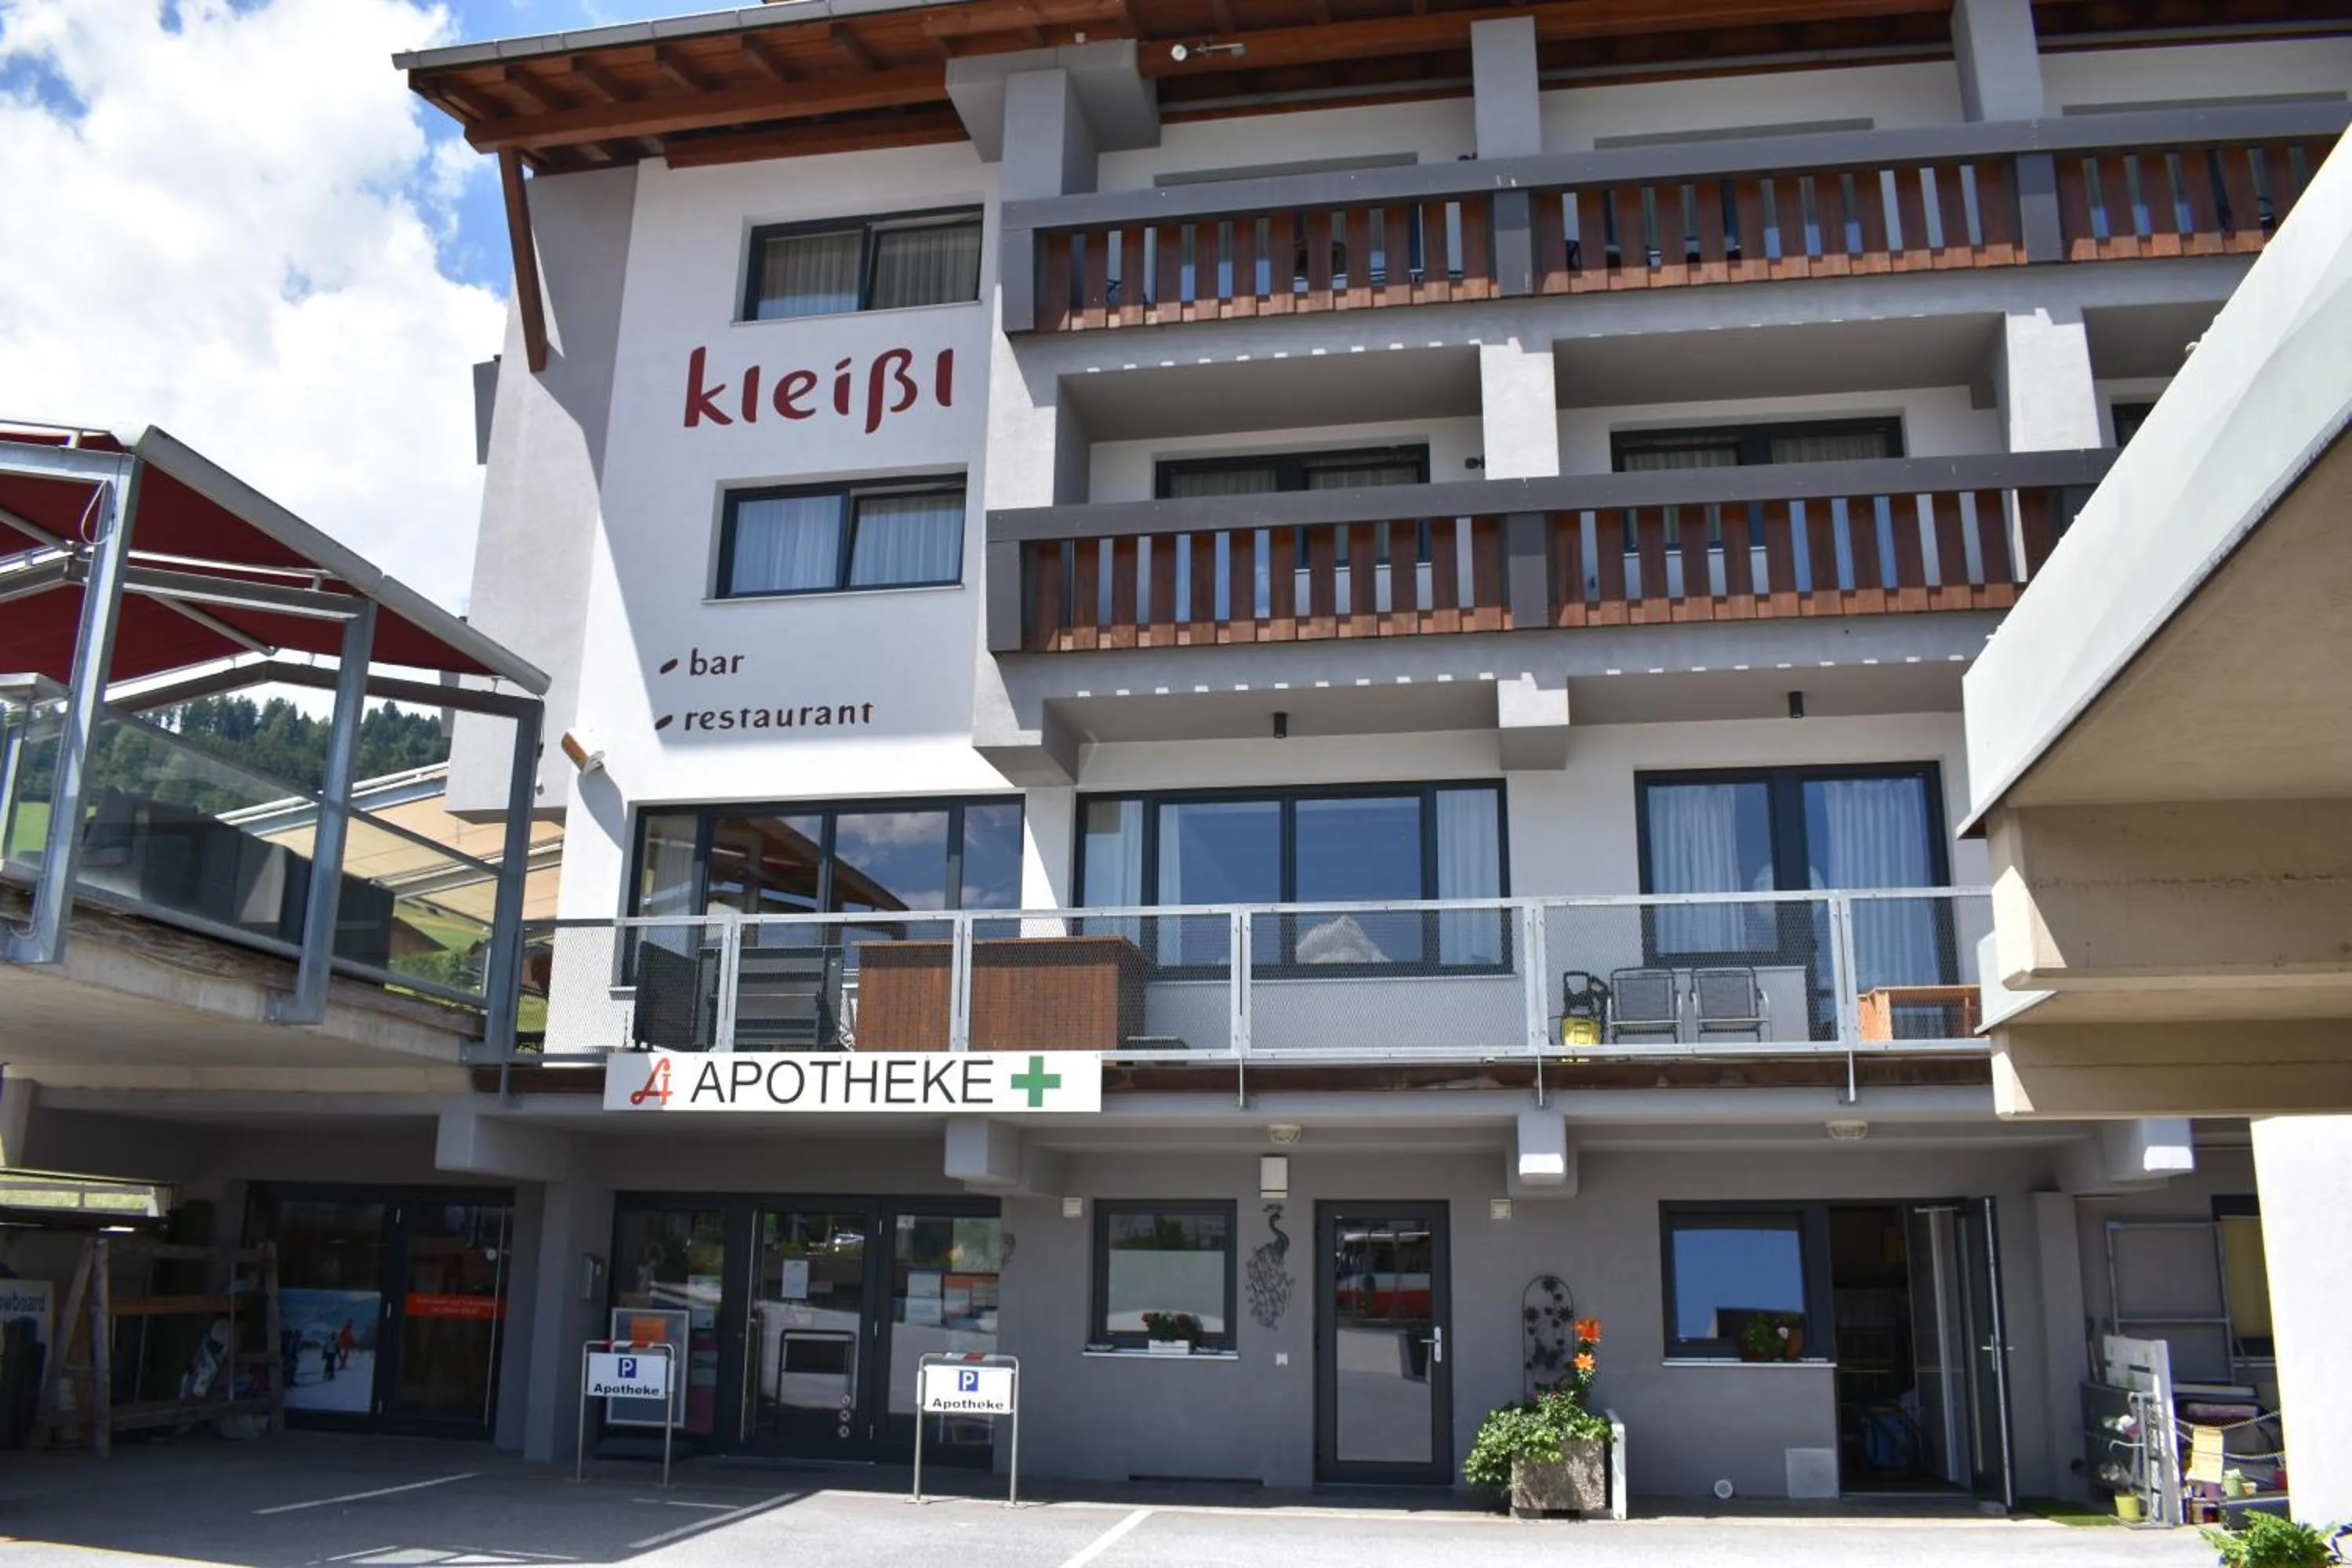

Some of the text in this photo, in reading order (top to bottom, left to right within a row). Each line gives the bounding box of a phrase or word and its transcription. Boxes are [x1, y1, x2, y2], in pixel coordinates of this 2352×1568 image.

[684, 346, 954, 434] kleißl
[689, 647, 745, 677] bar
[684, 702, 874, 731] restaurant
[690, 1059, 994, 1105] APOTHEKE
[622, 1359, 633, 1377] P
[593, 1383, 660, 1396] Apotheke
[962, 1371, 975, 1391] P
[931, 1397, 1004, 1410] Apotheke
